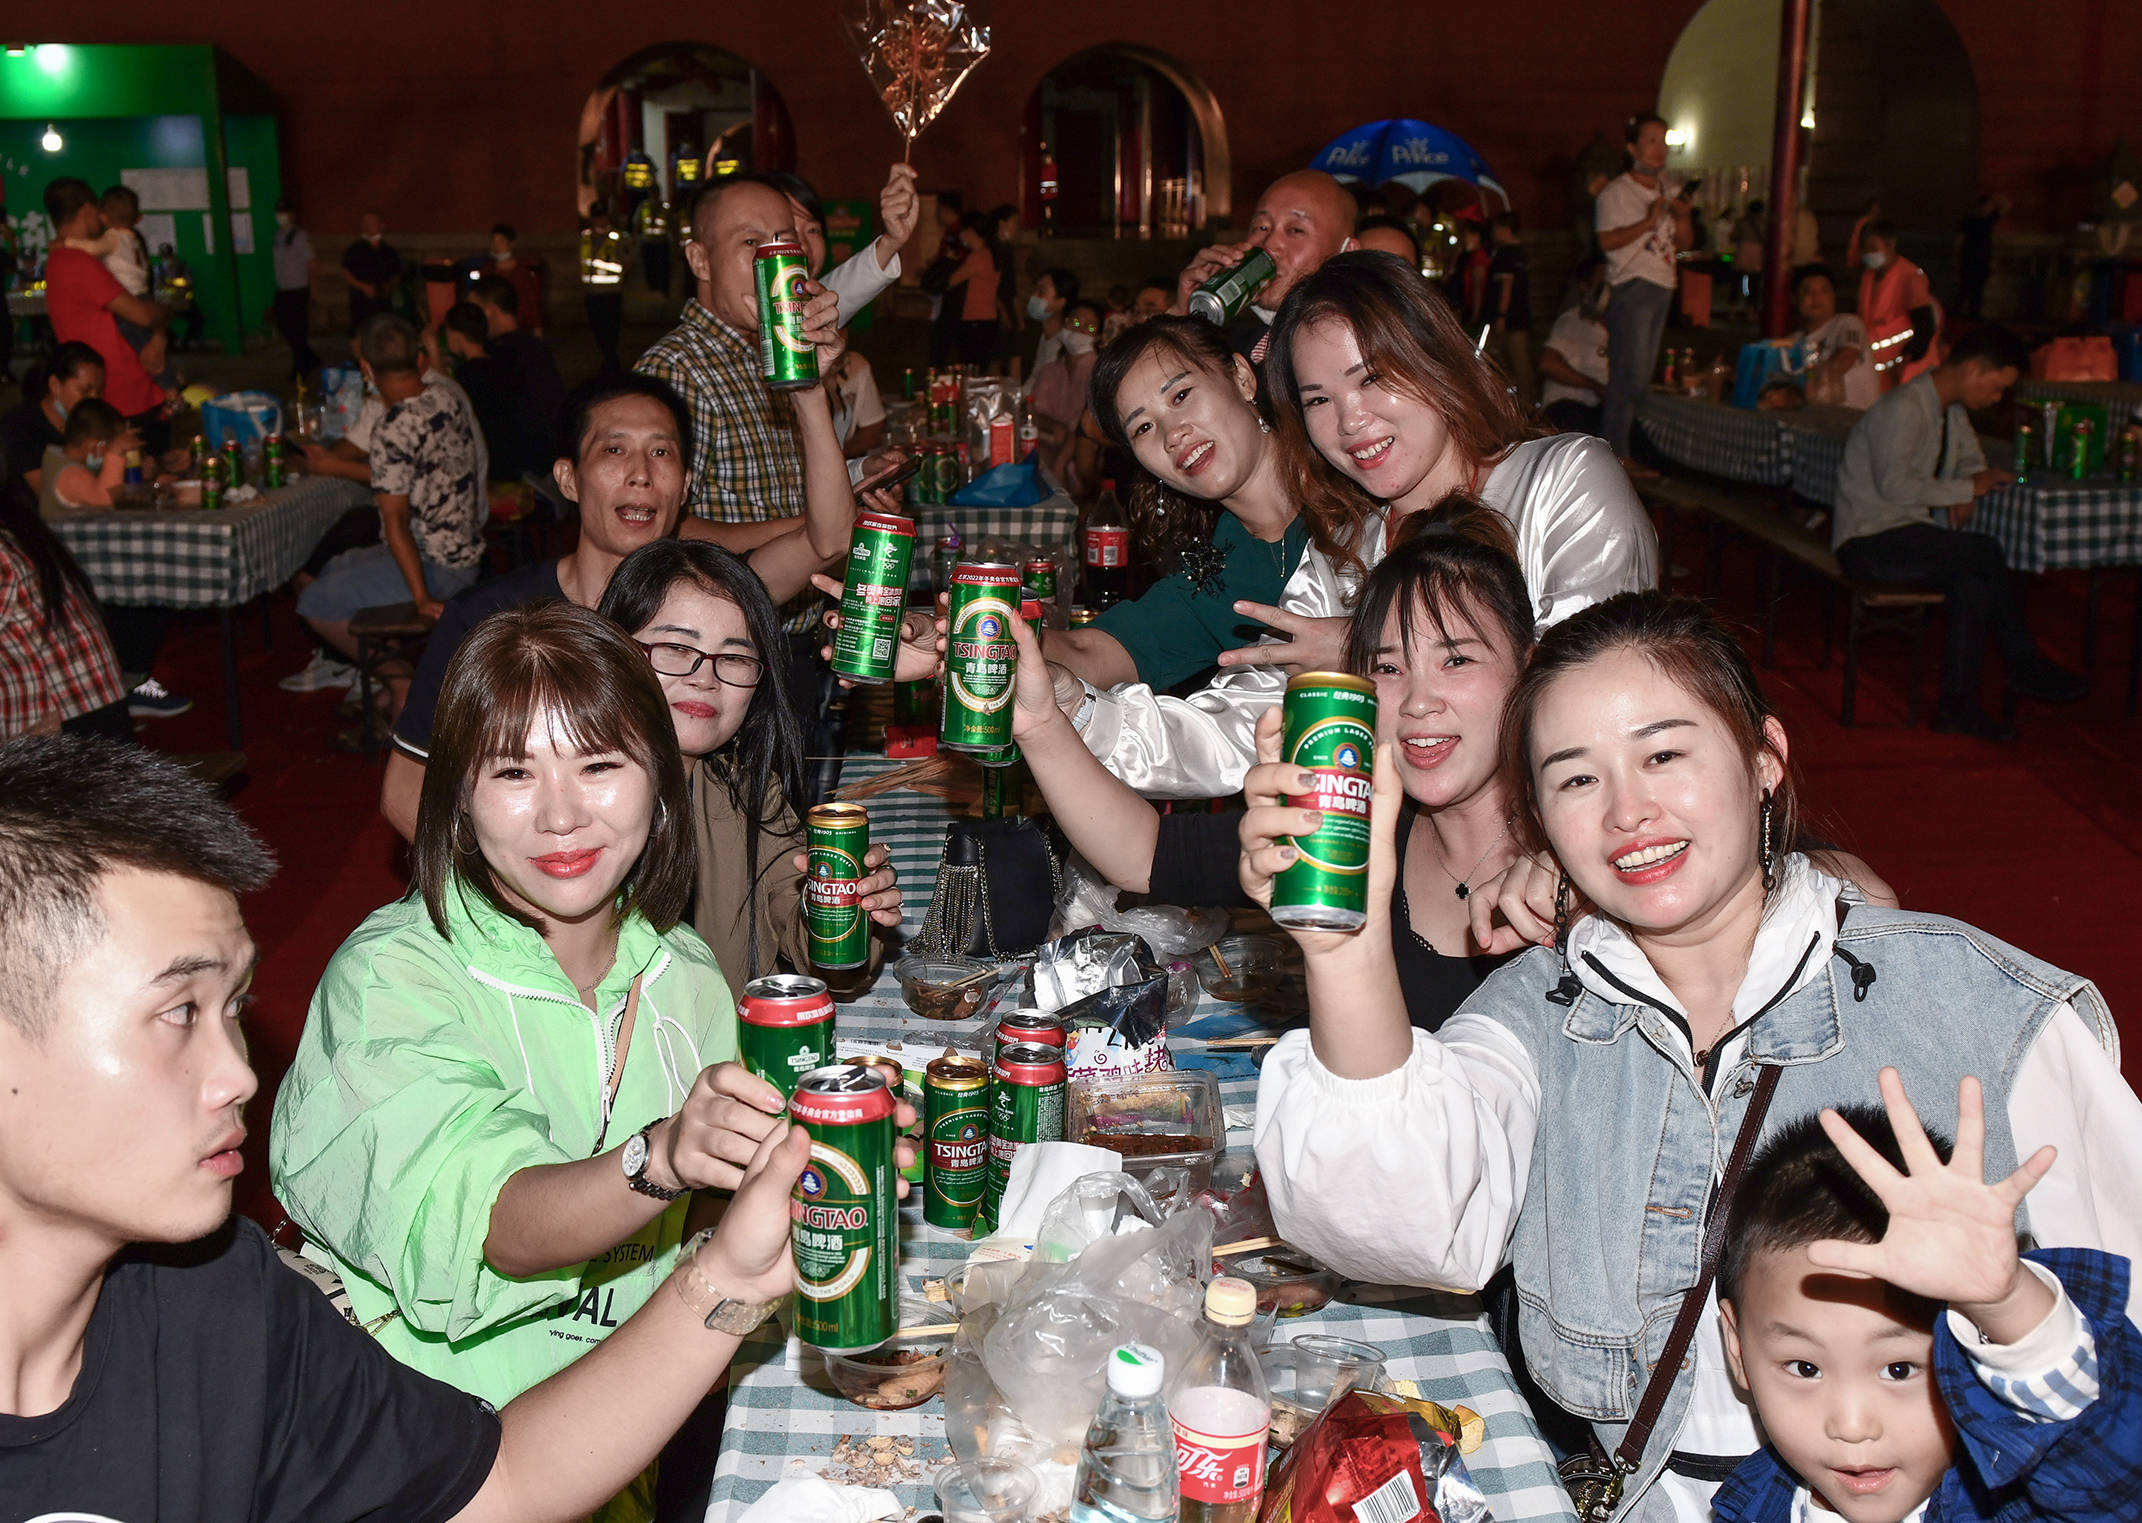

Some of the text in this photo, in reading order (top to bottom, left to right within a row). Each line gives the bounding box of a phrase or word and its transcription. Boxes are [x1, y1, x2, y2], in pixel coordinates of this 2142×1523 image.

[953, 641, 1017, 660] TSINGTAO
[965, 662, 1008, 675] 青岛啤酒
[1299, 691, 1328, 699] CLASSIC
[1303, 727, 1341, 750] PREMIUM
[1318, 794, 1367, 815] 青岛啤酒
[951, 1157, 984, 1168] 青岛啤酒
